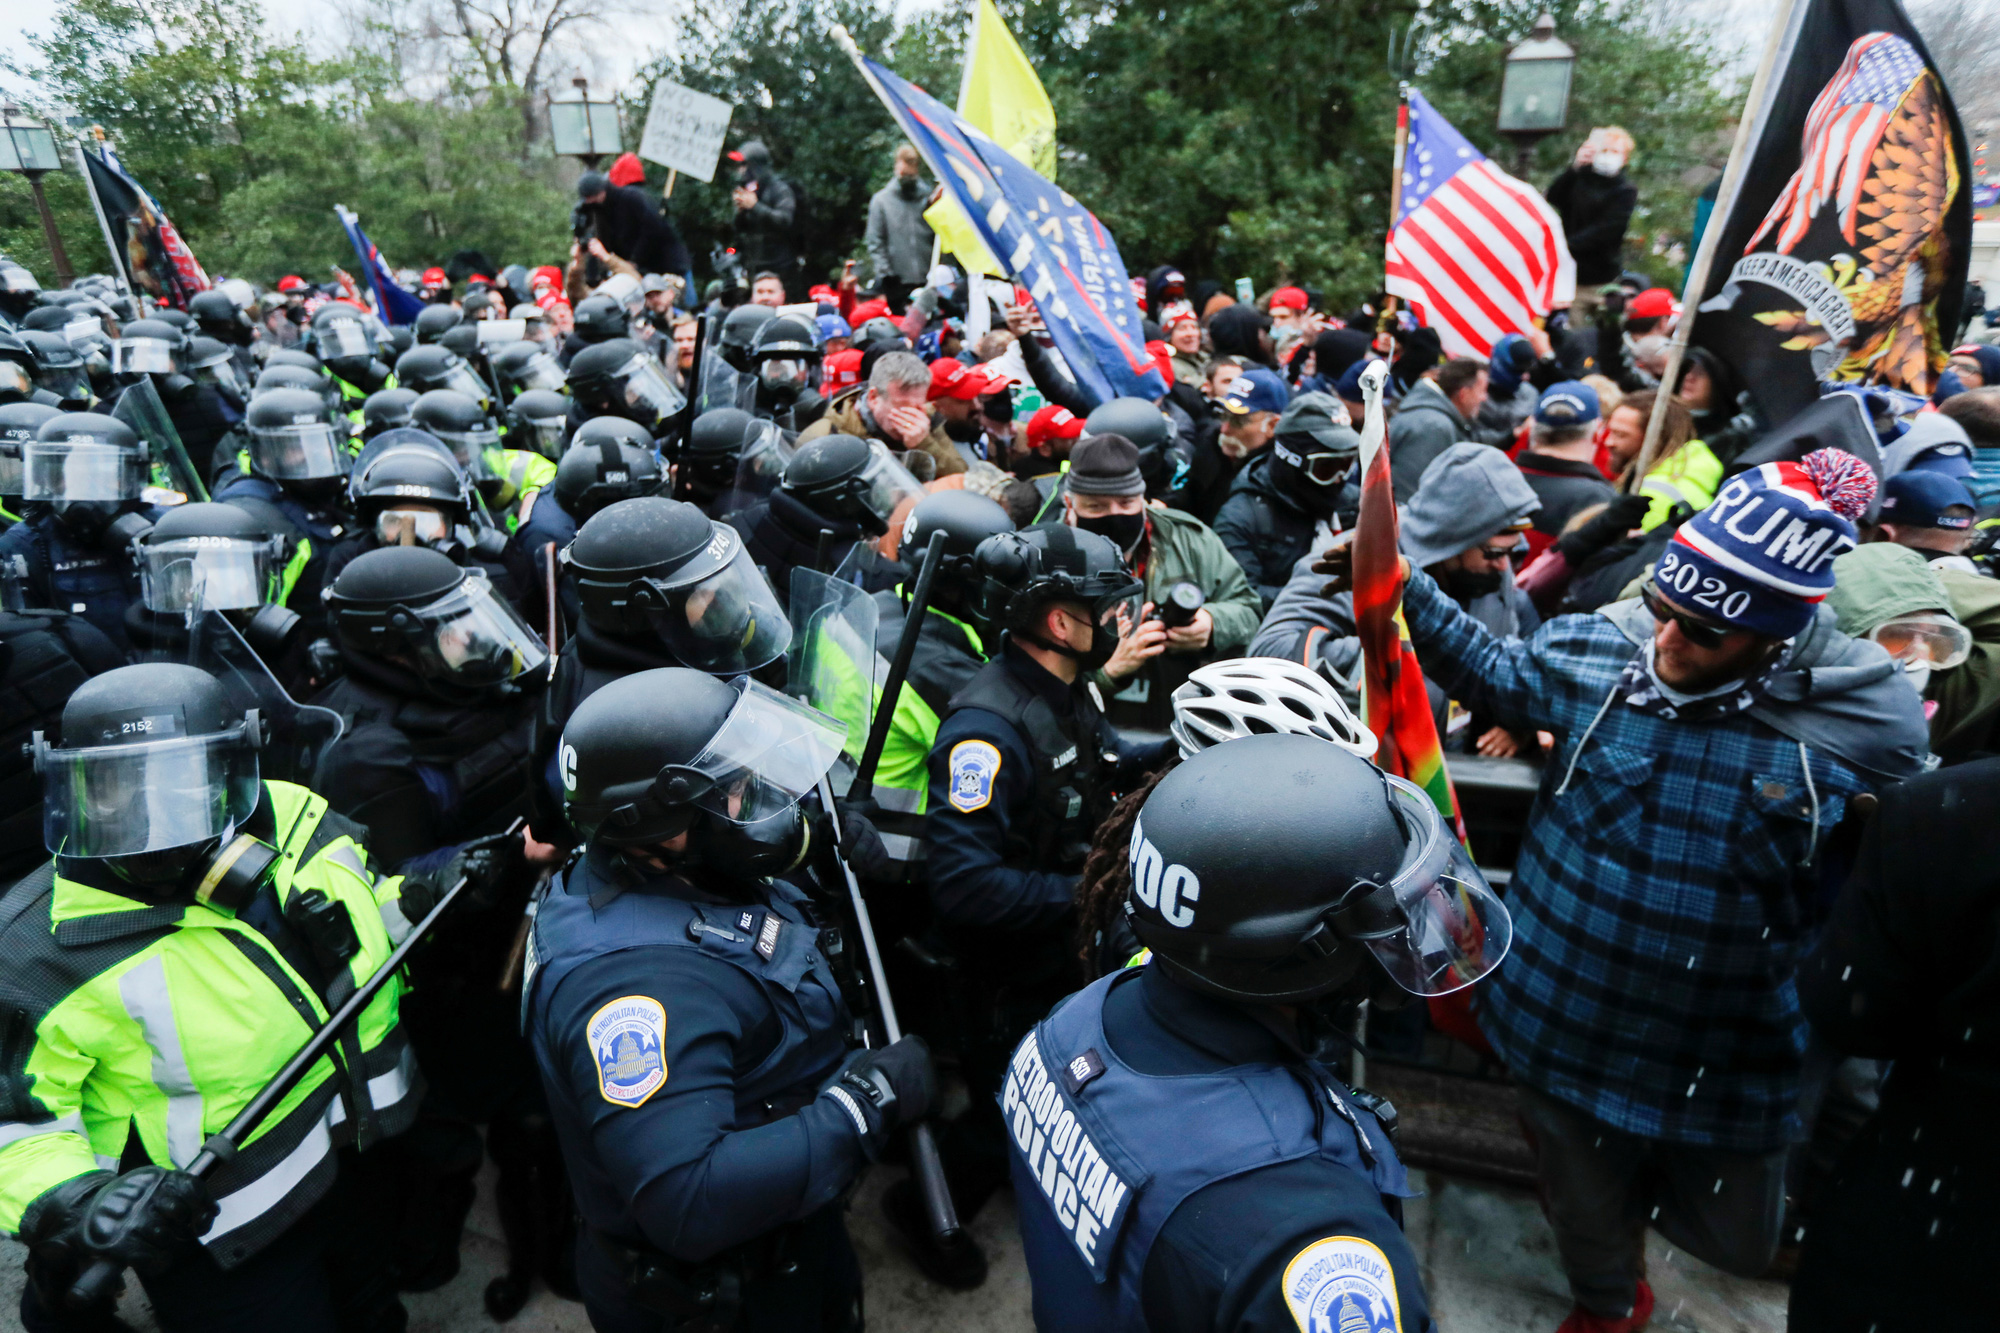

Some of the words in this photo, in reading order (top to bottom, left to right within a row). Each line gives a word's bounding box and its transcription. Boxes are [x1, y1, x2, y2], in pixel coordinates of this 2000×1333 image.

[1738, 258, 1768, 276] KEEP
[1764, 259, 1829, 305] AMERICA
[1817, 294, 1851, 336] GREAT
[1703, 474, 1858, 574] RUMP
[1657, 552, 1752, 619] 2020
[122, 720, 153, 734] 2152
[1129, 807, 1200, 928] PDC
[740, 911, 753, 930] POLICE
[759, 941, 774, 954] G.
[591, 1006, 637, 1040] METROPOLITAN
[637, 1006, 661, 1025] POLICE
[606, 1084, 630, 1098] DISTRICT
[636, 1071, 662, 1094] COLUMBIA
[1069, 1056, 1092, 1082] SSD
[1012, 1031, 1127, 1229] METROPOLITAN
[1003, 1071, 1101, 1267] POLICE
[1292, 1252, 1354, 1305] METROPOLITAN
[1354, 1253, 1388, 1283] POLICE
[1315, 1283, 1342, 1315] JUSTITIA
